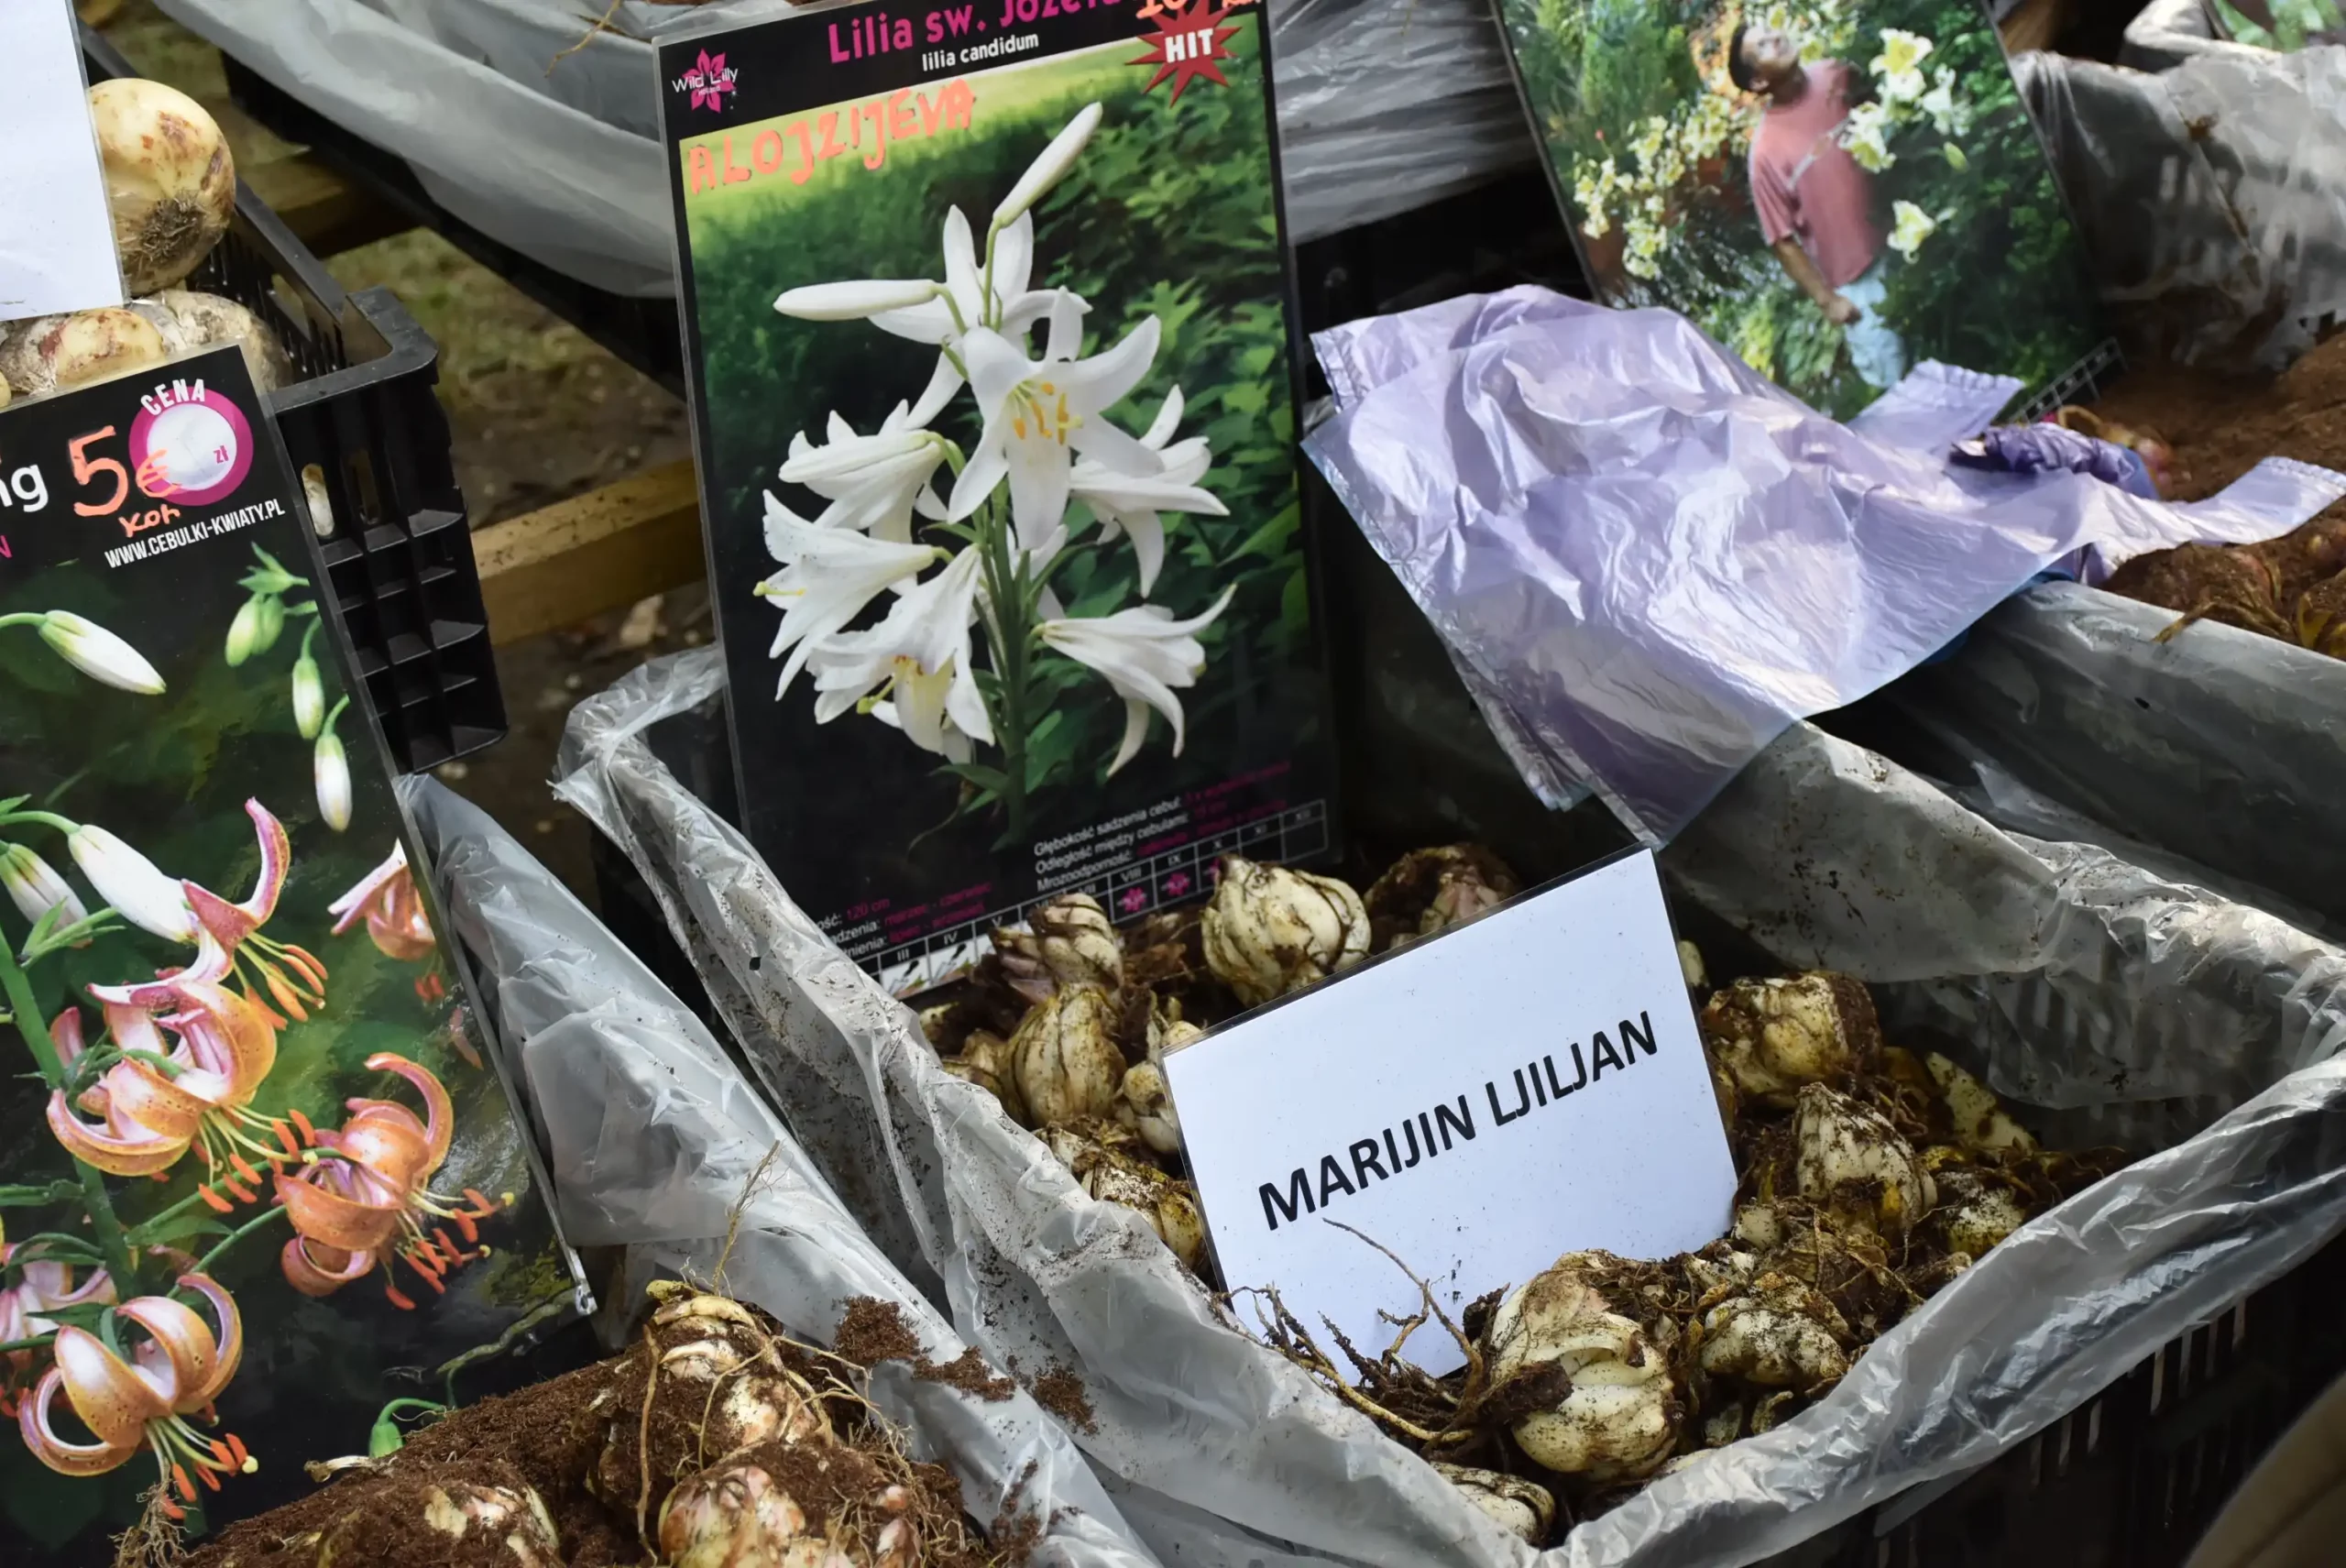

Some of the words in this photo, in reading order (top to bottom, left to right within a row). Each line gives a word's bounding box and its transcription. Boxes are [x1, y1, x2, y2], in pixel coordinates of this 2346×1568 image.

[828, 12, 913, 63] Lilia
[923, 51, 956, 71] lilia
[960, 34, 1039, 63] candidum
[1165, 28, 1213, 63] HIT
[672, 72, 704, 93] Wild
[710, 67, 739, 84] Lilly
[689, 78, 976, 194] ALOJZIJEVA
[140, 378, 205, 415] CENA
[104, 499, 285, 568] WWW.CEBULKI-KWIATY.PL
[944, 932, 959, 946] IV
[1258, 1094, 1476, 1231] MARIJIN
[1485, 1010, 1658, 1127] LJILJAN
